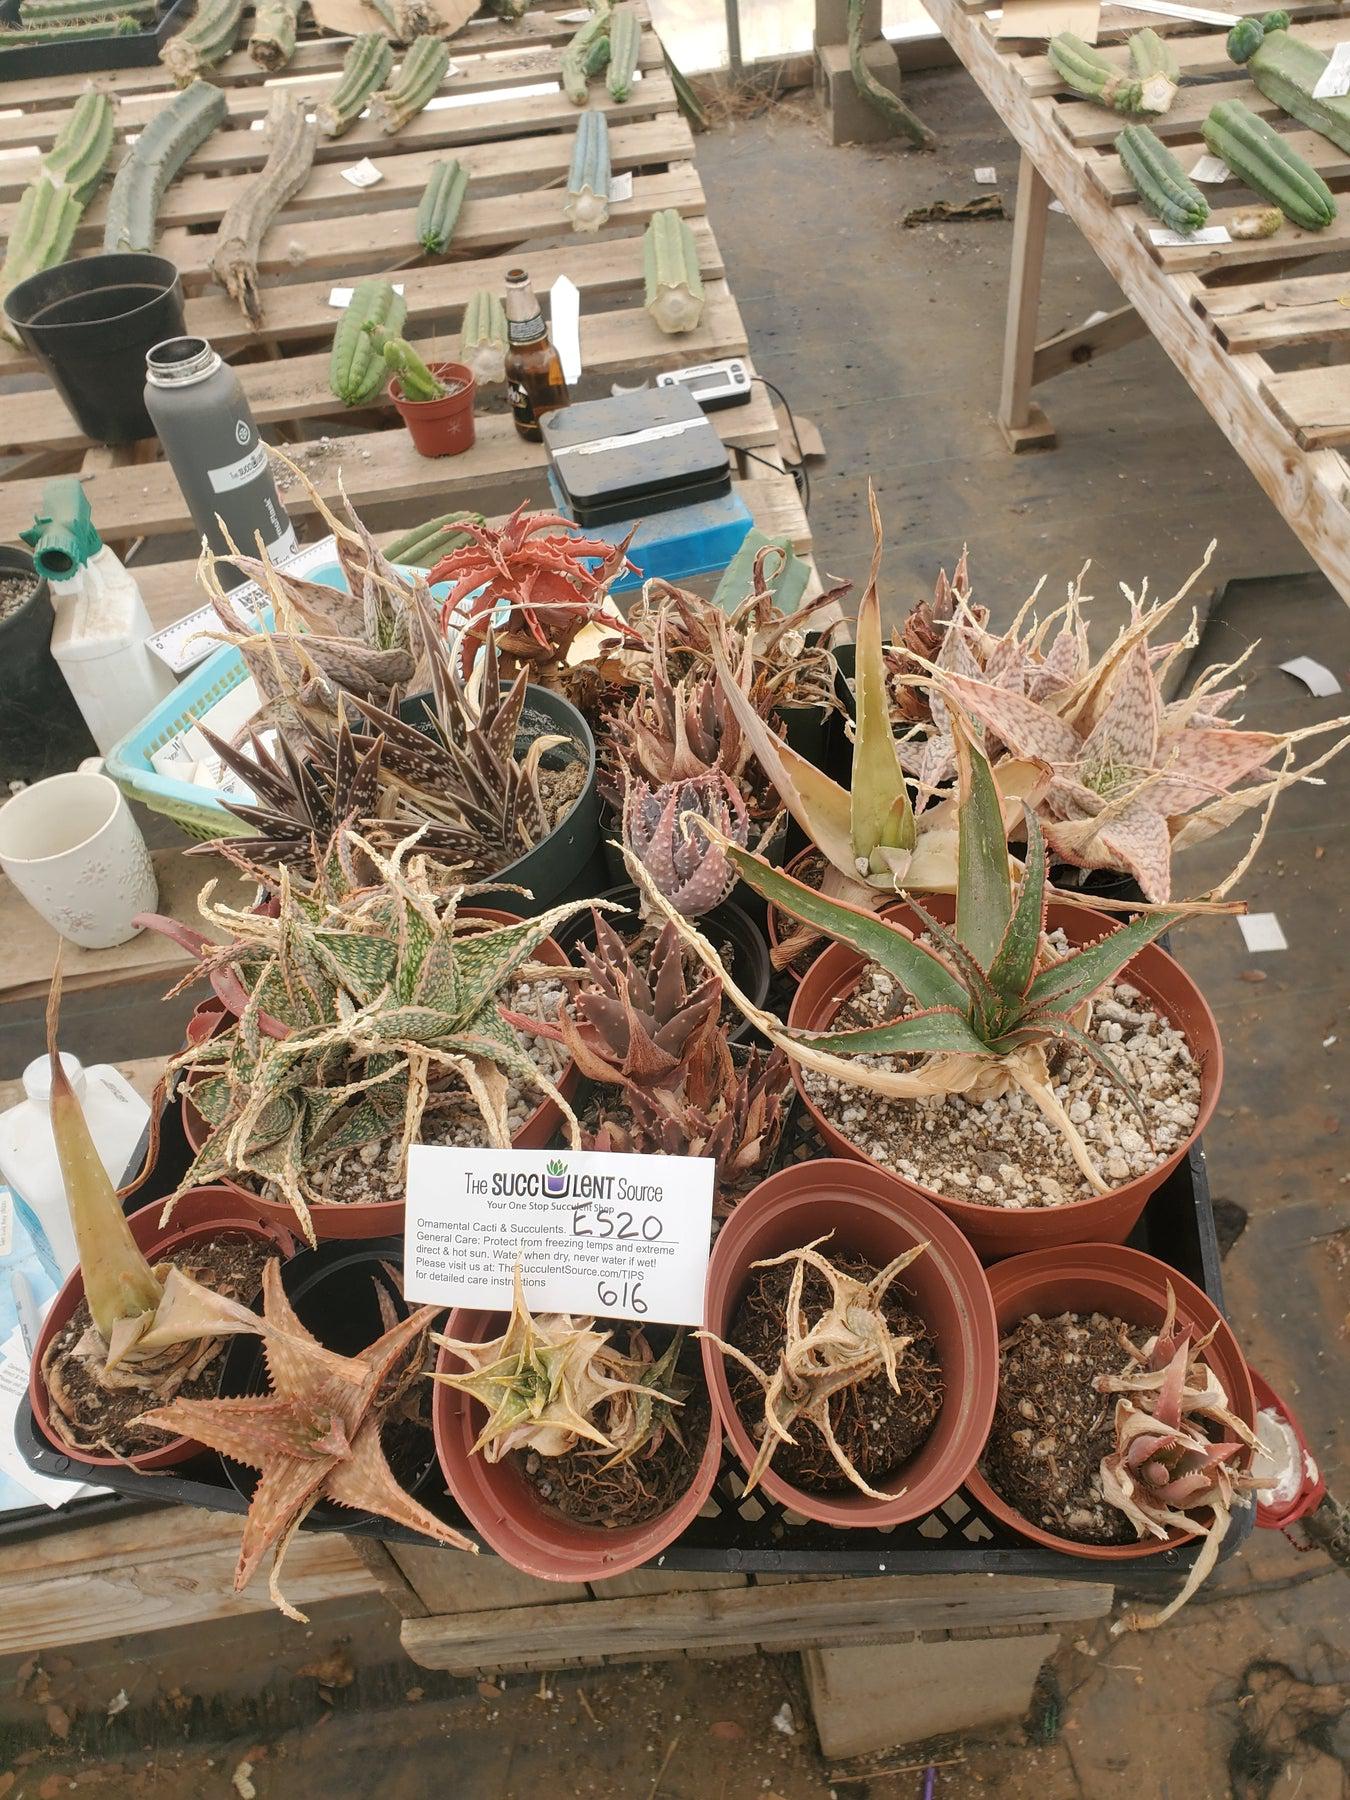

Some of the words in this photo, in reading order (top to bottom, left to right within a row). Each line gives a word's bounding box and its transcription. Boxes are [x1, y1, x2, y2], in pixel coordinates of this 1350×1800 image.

[465, 1172, 488, 1195] The
[491, 1172, 616, 1199] SUCCULENT
[617, 1177, 663, 1202] Source
[486, 1200, 507, 1210] Your
[508, 1201, 527, 1211] One
[528, 1201, 549, 1212] Stop
[551, 1202, 592, 1212] Succulent
[593, 1203, 615, 1216] Shop
[416, 1218, 470, 1231] Ornamental
[472, 1222, 498, 1233] Cacti
[499, 1223, 507, 1233] &
[510, 1223, 567, 1235] Succulents.
[416, 1231, 452, 1244] General
[454, 1234, 480, 1245] Care:
[482, 1235, 518, 1247] Protect
[519, 1237, 543, 1248] from
[545, 1237, 584, 1250] freezing
[586, 1239, 614, 1252] temps
[615, 1242, 634, 1253] and
[635, 1244, 675, 1255] extreme
[415, 1244, 441, 1255] direct
[443, 1246, 450, 1255] &
[452, 1246, 467, 1257] hot
[469, 1249, 490, 1259] sun.
[524, 1251, 551, 1261] when
[553, 1252, 571, 1263] dry,
[573, 1254, 600, 1263] never
[601, 1256, 627, 1266] water
[628, 1256, 635, 1266] if
[636, 1257, 657, 1268] wet!
[415, 1257, 446, 1269] Please
[448, 1260, 467, 1270] visit
[469, 1263, 481, 1271] us
[482, 1262, 495, 1272] at:
[415, 1269, 428, 1280] for
[429, 1271, 465, 1283] detailed
[467, 1276, 489, 1284] care
[597, 1281, 648, 1314] 616
